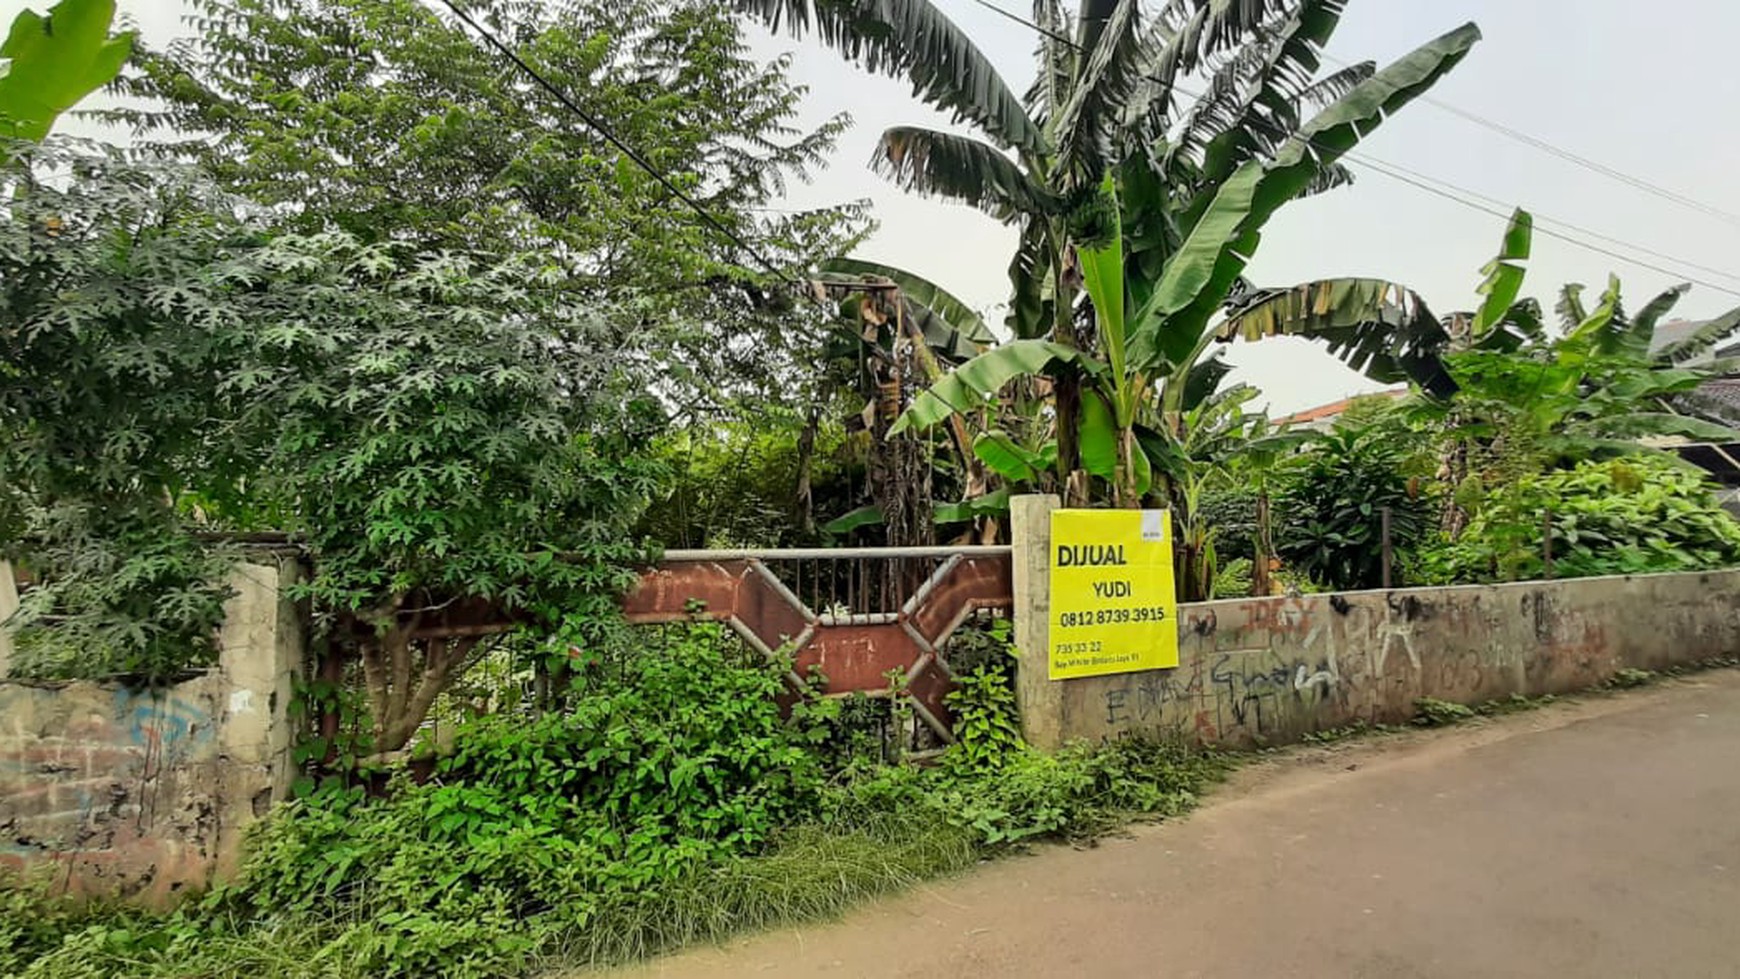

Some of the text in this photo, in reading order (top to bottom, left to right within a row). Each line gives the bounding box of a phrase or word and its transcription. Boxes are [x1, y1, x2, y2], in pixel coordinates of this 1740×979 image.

[1057, 544, 1127, 567] DIJUAL
[1092, 581, 1131, 598] YUDI
[1060, 606, 1165, 628] 0812 8739 3915
